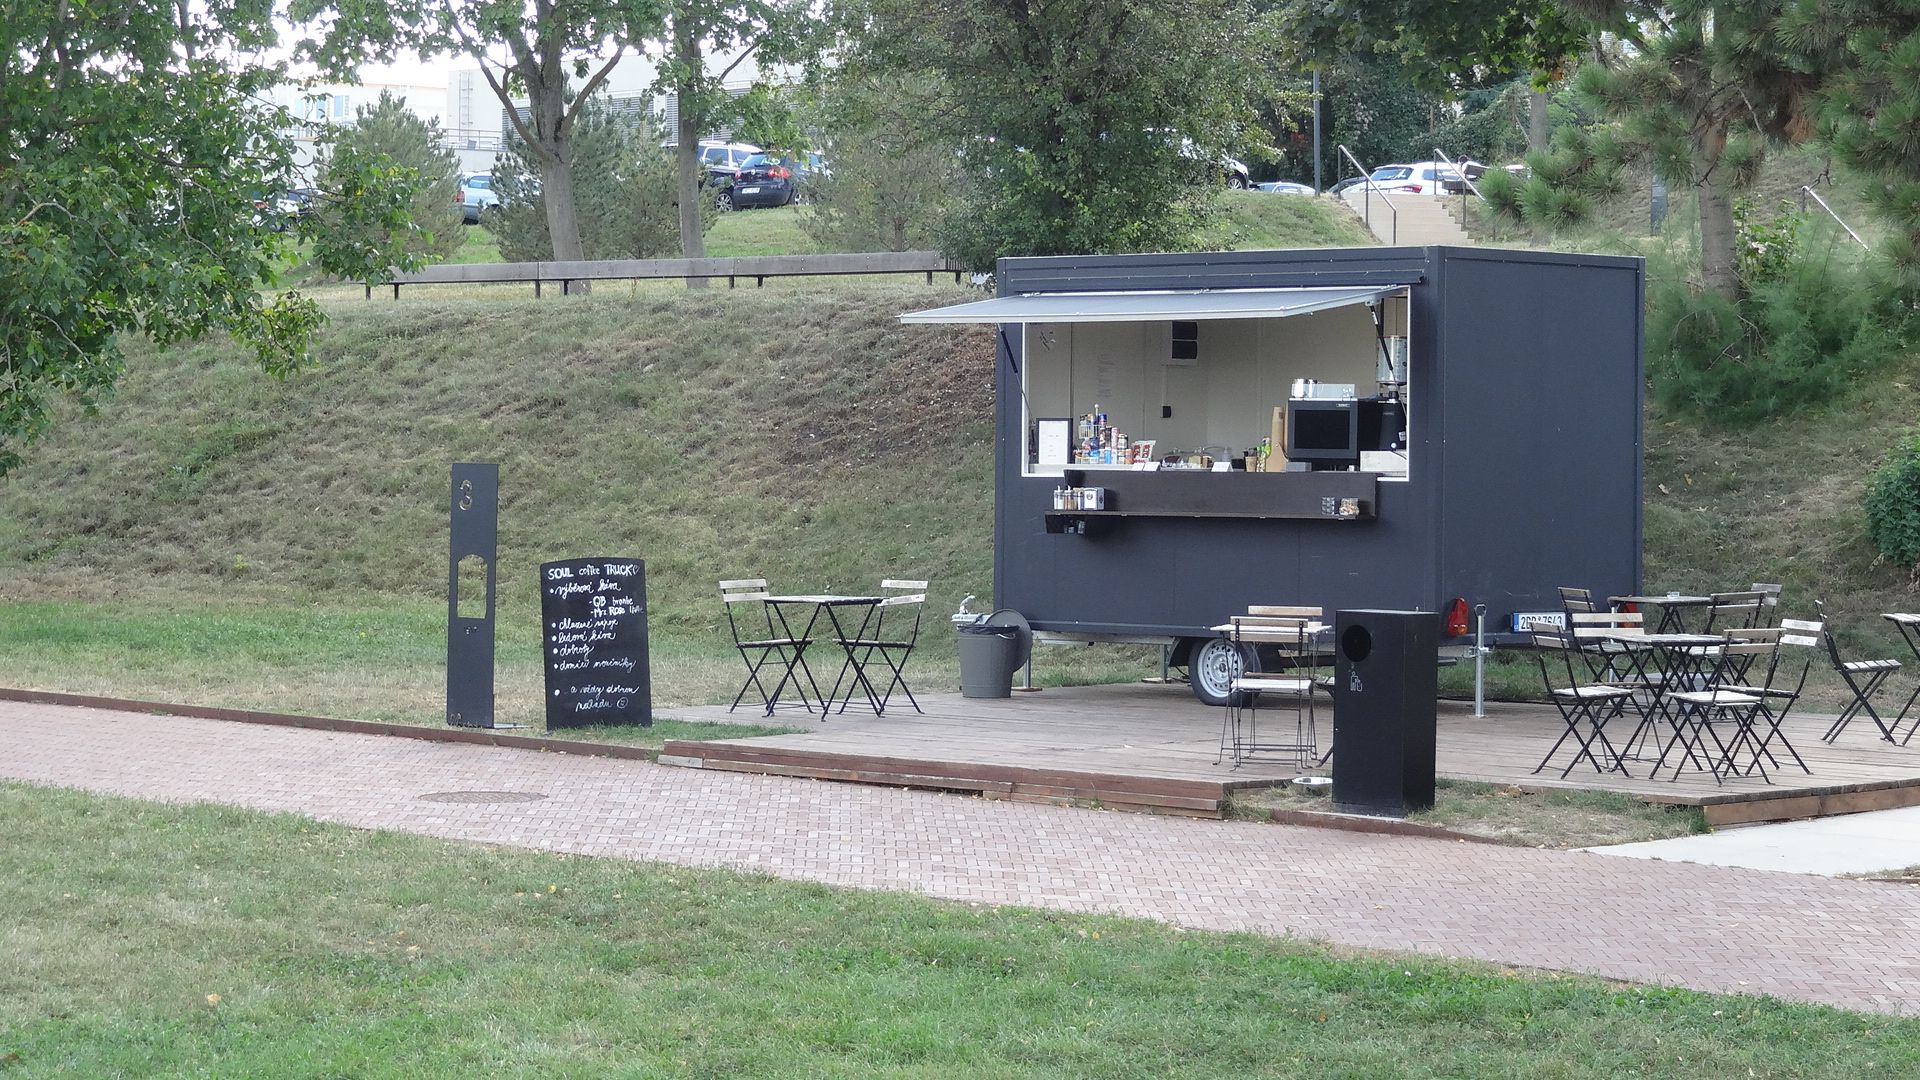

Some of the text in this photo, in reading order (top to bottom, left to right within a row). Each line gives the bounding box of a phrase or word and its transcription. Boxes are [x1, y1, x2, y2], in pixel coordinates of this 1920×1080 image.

[459, 479, 473, 511] 3
[548, 564, 633, 580] SOUL coffee TRUCK
